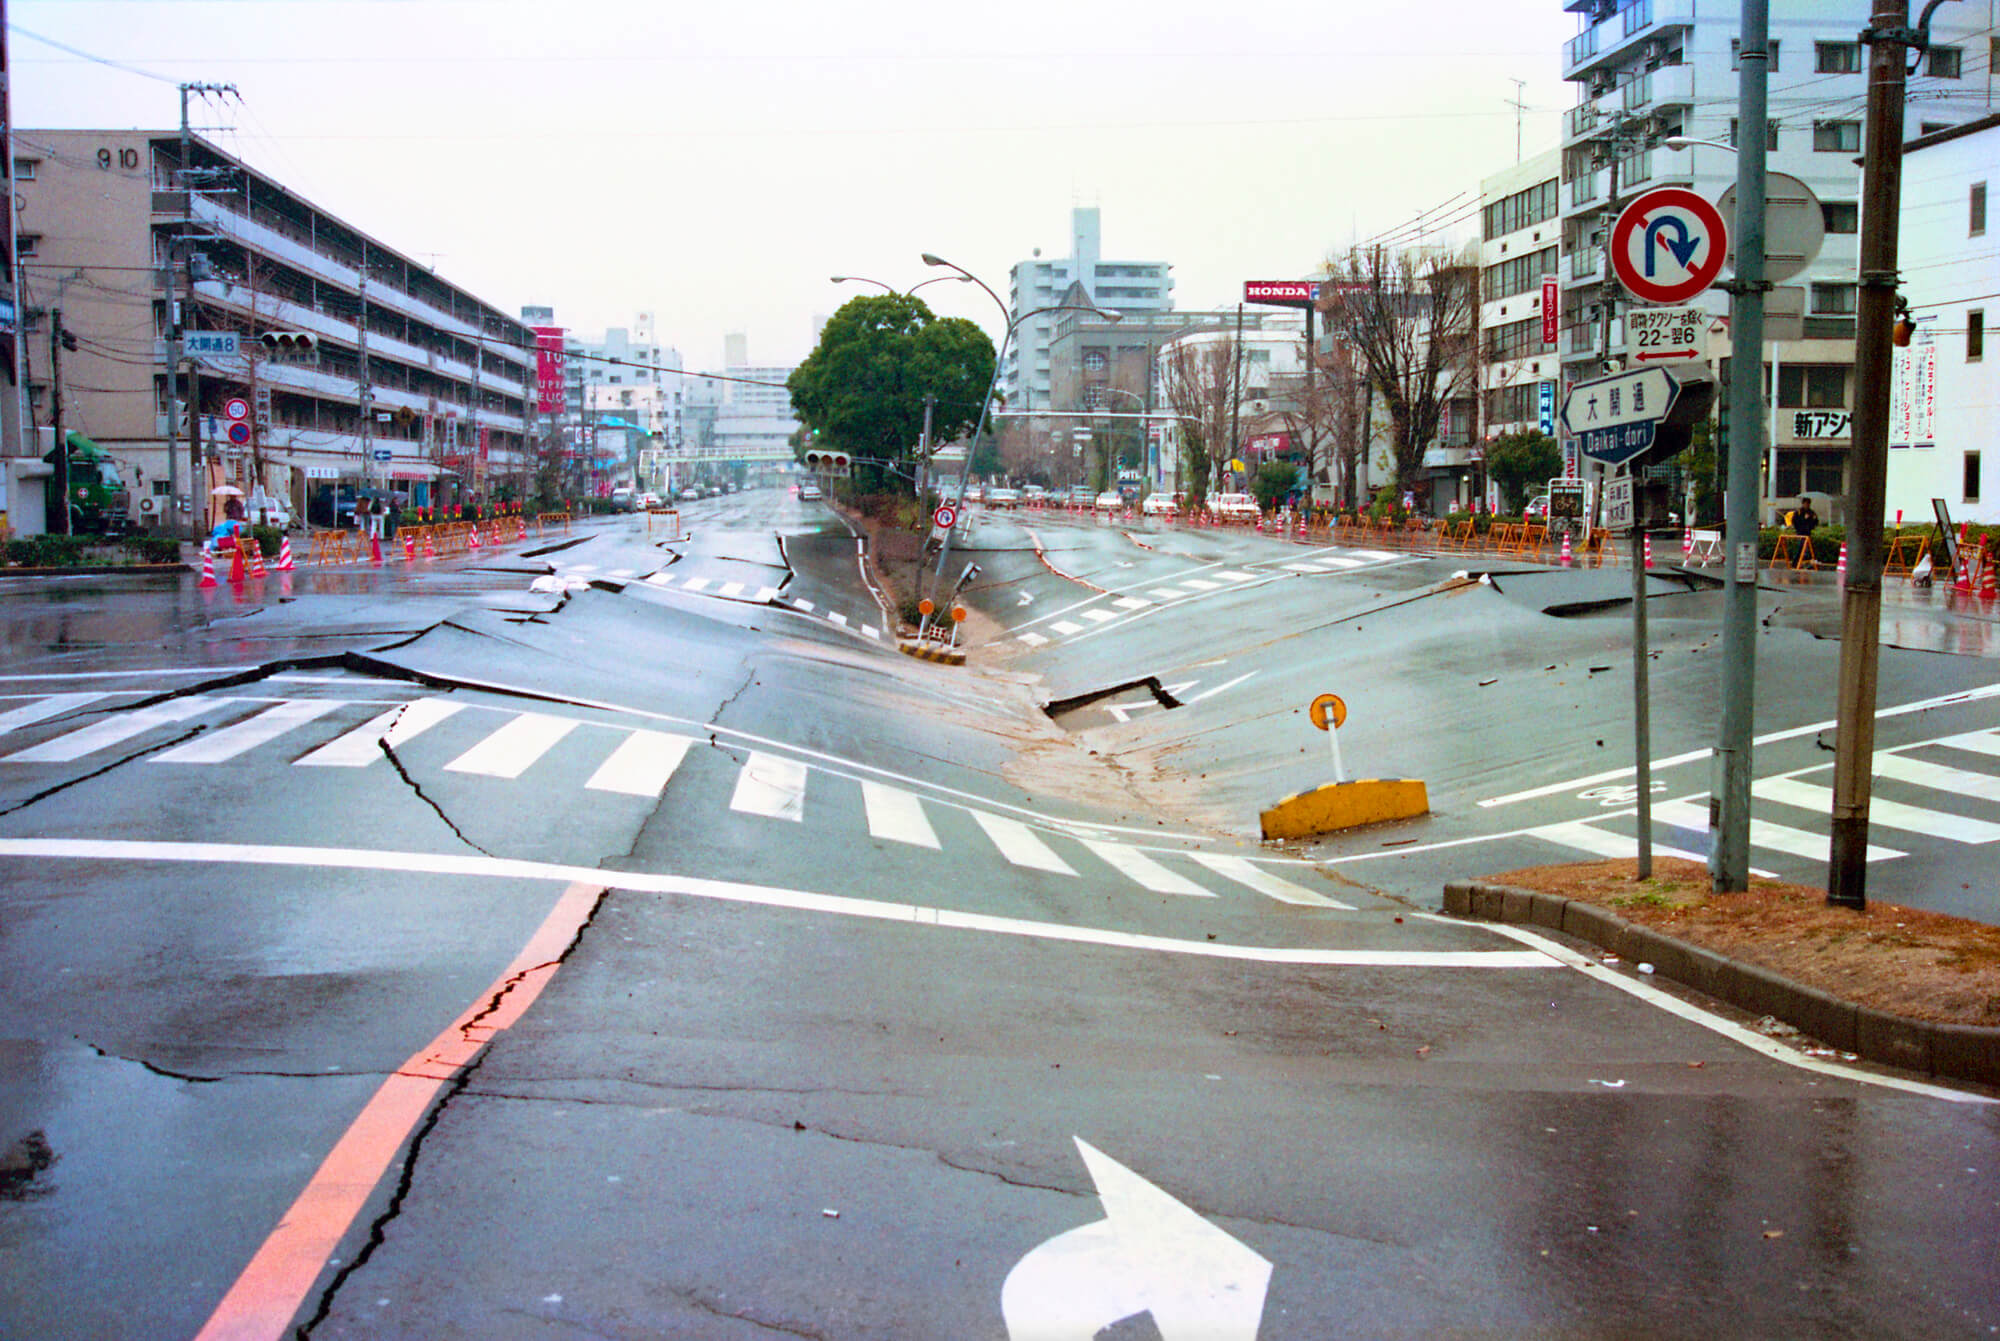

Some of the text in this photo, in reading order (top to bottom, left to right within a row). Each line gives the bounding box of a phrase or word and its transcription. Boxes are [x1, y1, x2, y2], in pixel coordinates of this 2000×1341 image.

[119, 148, 138, 169] 10
[1248, 287, 1307, 296] HONDA
[1588, 382, 1645, 421] 大開通
[1587, 422, 1647, 453] Daikai-dori
